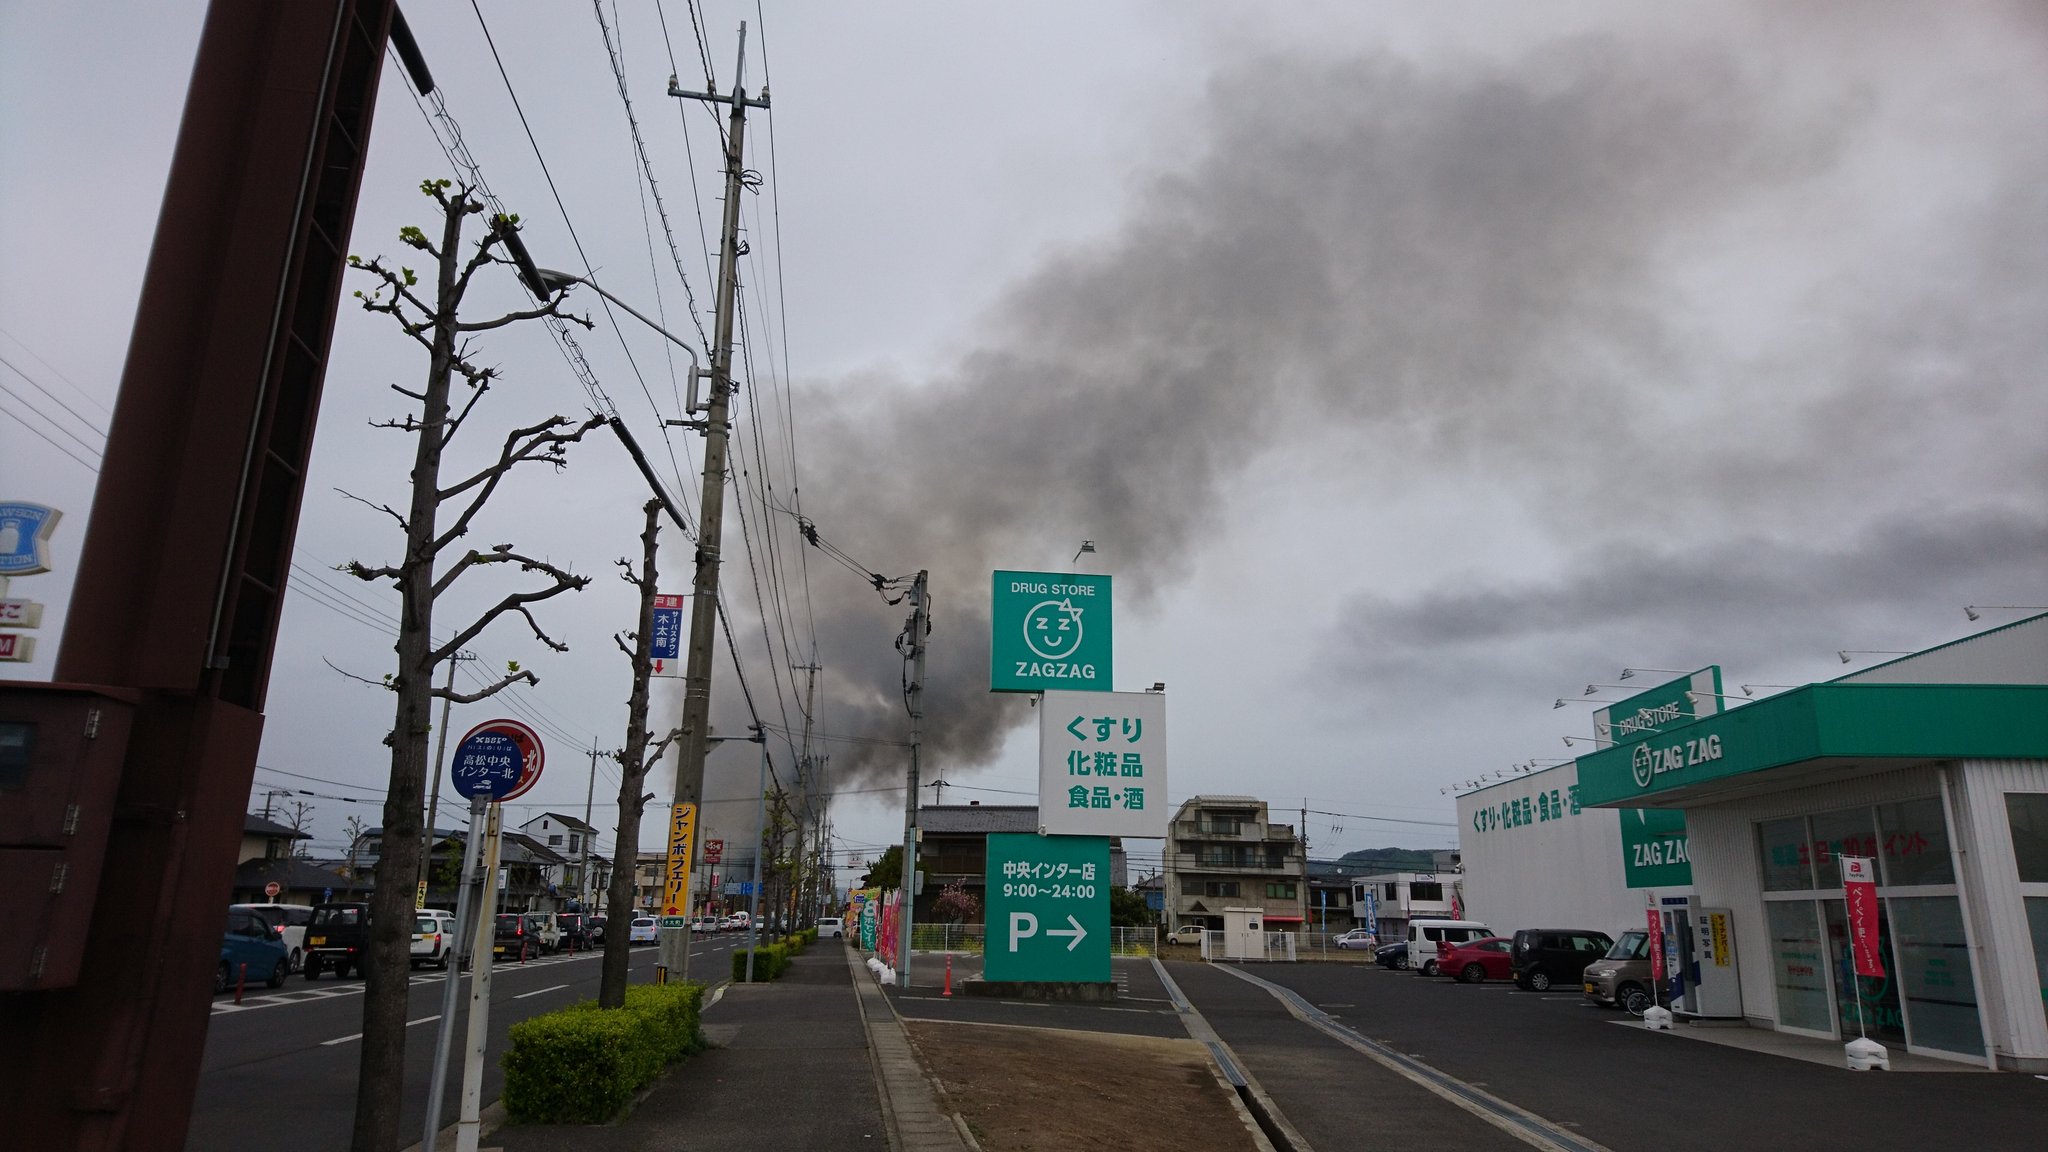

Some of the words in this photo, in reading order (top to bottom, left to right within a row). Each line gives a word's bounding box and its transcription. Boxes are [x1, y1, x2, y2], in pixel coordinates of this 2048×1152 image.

[1011, 581, 1048, 595] DRUG
[1051, 584, 1096, 597] STORE
[655, 613, 670, 648] 木太南
[1015, 661, 1096, 680] ZAGZAG
[1066, 715, 1143, 744] くすり
[1619, 714, 1645, 736] DRUG
[1647, 701, 1680, 727] STORE
[463, 755, 511, 768] 高松中央
[1067, 750, 1144, 778] 化粧品
[1652, 744, 1685, 774] ZAG
[1686, 734, 1723, 766] ZAG
[458, 766, 515, 780] インター北
[1068, 784, 1145, 811] 食品・酒
[1632, 841, 1663, 867] ZAG
[1003, 860, 1096, 882] 中央インター店
[1008, 911, 1039, 953] P
[1699, 915, 1712, 959] 証明写真
